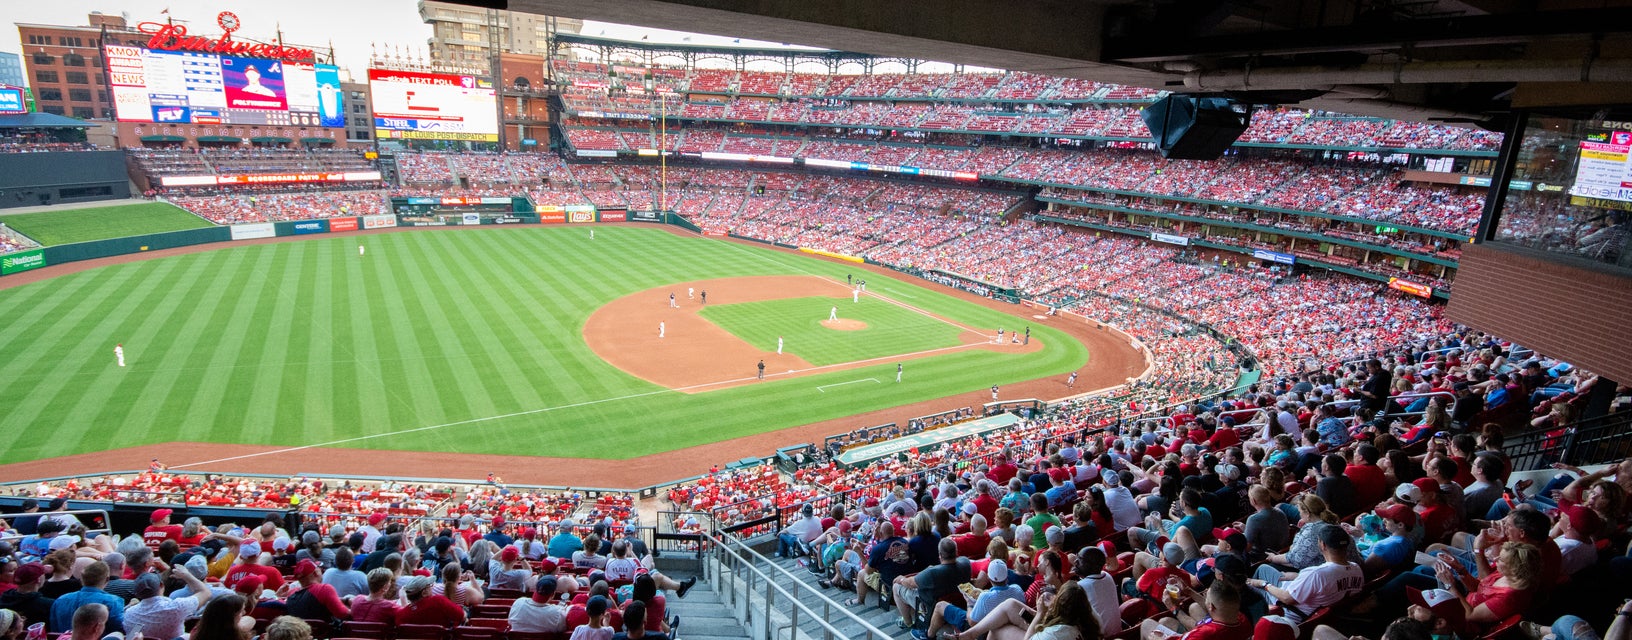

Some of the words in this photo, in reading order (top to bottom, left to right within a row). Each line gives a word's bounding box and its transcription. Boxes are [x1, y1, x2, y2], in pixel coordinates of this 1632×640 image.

[138, 22, 315, 59] Budweiser
[108, 47, 140, 57] KMOX
[113, 74, 145, 84] NEWS
[158, 110, 184, 121] FLY
[414, 131, 434, 139] LOUIS
[436, 132, 487, 140] POST-DISPATCH
[12, 252, 42, 265] National
[1337, 577, 1362, 592] MOLINA
